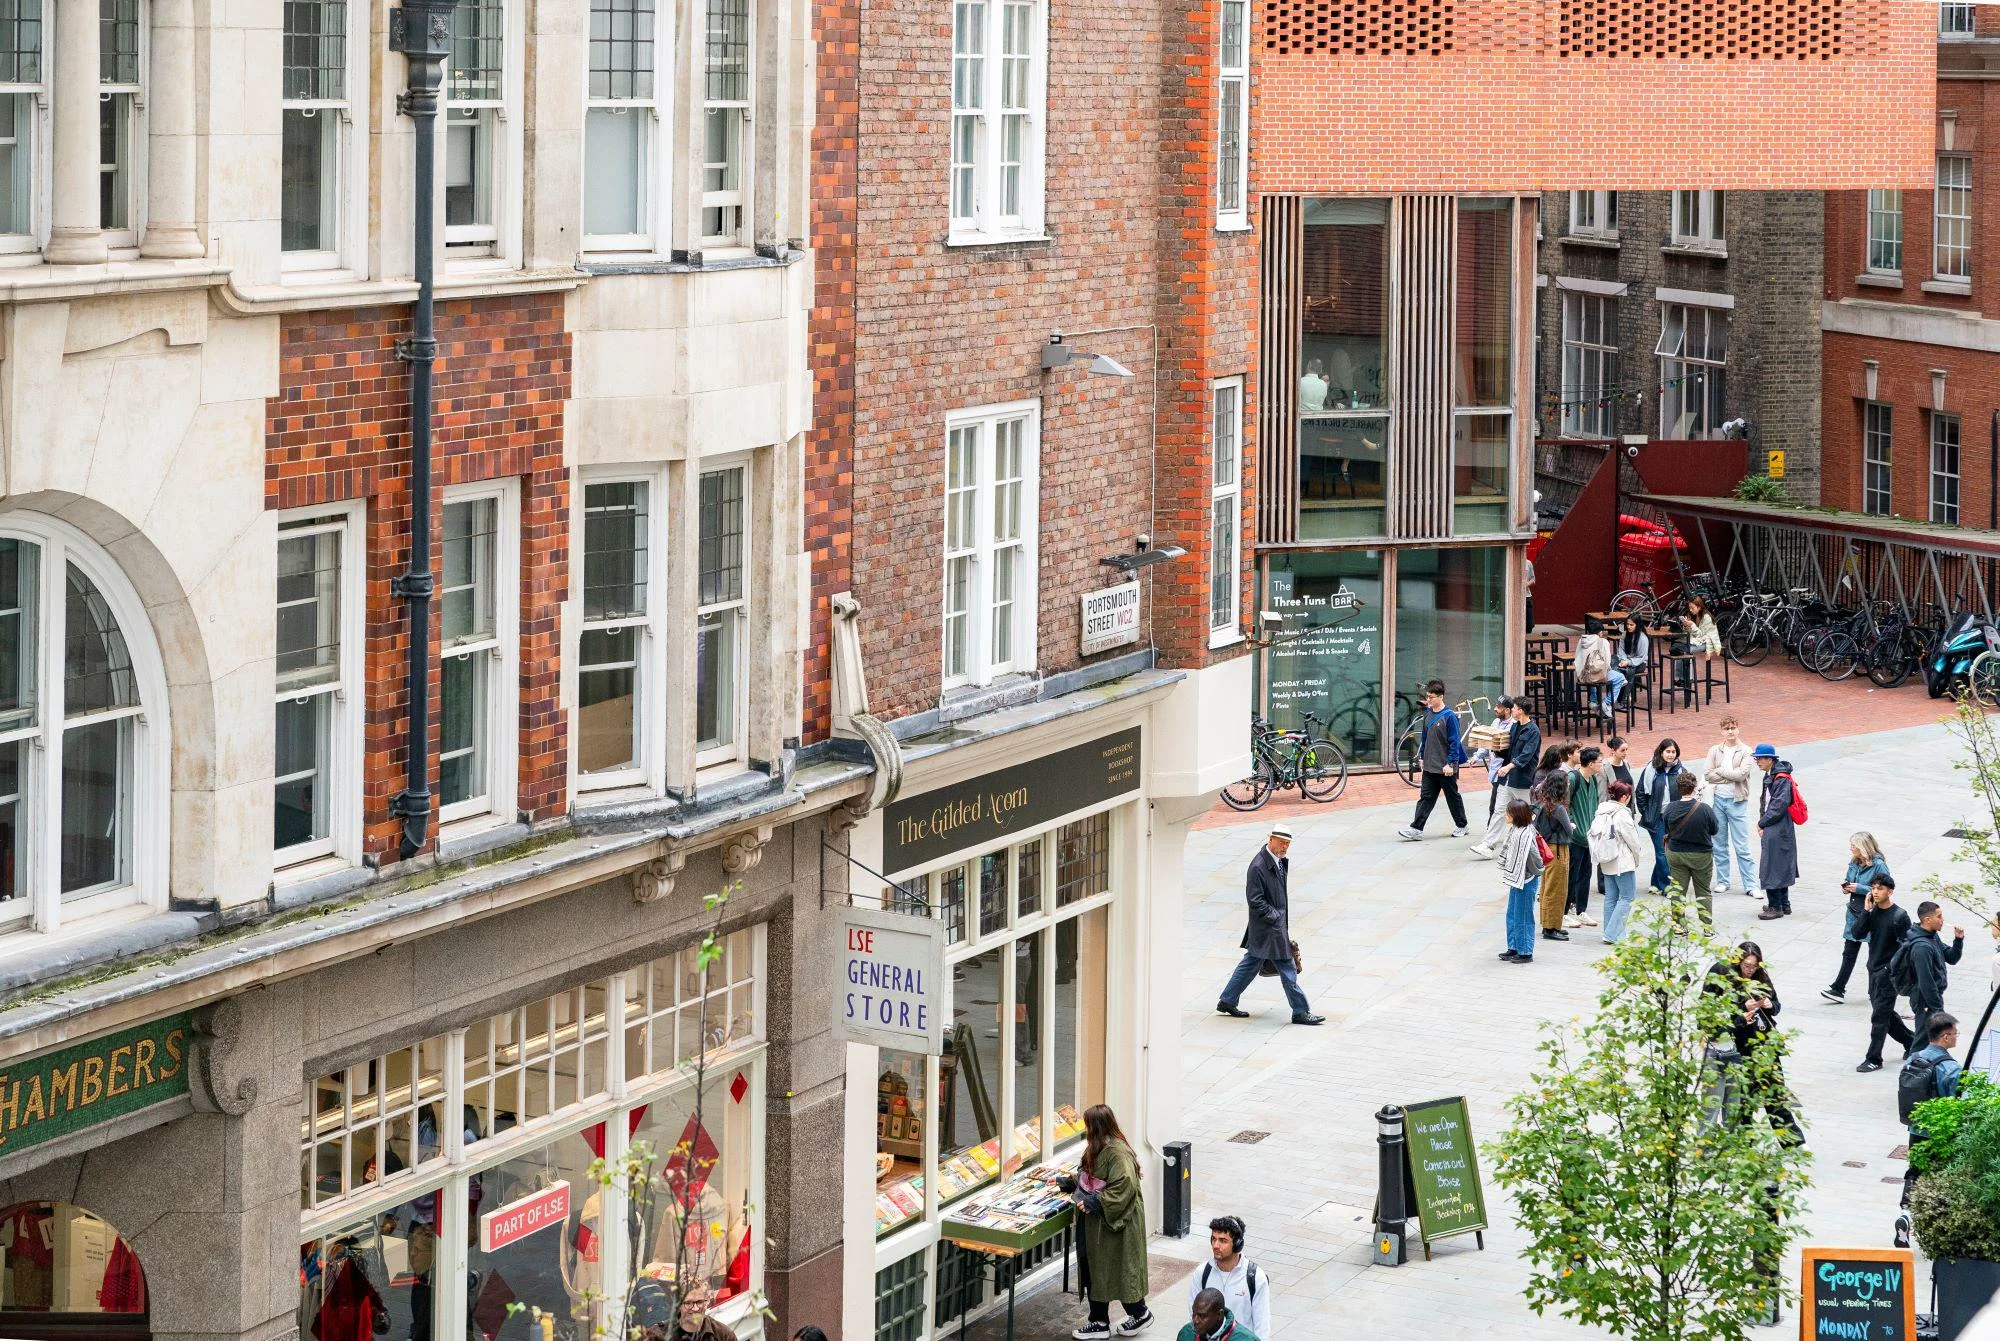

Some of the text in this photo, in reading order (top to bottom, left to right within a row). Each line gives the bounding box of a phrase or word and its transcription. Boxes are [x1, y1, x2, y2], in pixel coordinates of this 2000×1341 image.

[1274, 580, 1291, 591] The
[1087, 588, 1137, 616] PORTSMOUTH
[1273, 594, 1326, 607] Three Tuns
[1334, 596, 1352, 606] BAR
[1087, 609, 1133, 635] STREET WC2
[1284, 628, 1300, 636] Music
[1304, 628, 1321, 636] Sorts
[1272, 680, 1300, 688] MONDAY
[1272, 691, 1291, 700] Weekly
[1297, 690, 1311, 699] Daily
[1102, 741, 1134, 758] INDEPENDENT
[1108, 755, 1134, 770] BOOKSHOP
[1108, 772, 1121, 784] SINCE
[897, 786, 1028, 846] The Gilded Acorn
[848, 928, 874, 954] LSE
[847, 958, 925, 995] GENERAL
[846, 992, 927, 1030] STORE
[0, 1028, 184, 1140] HAMBERS
[1415, 1116, 1459, 1137] We are Open
[1429, 1138, 1454, 1152] Please
[1423, 1158, 1444, 1172] Come
[1451, 1153, 1466, 1169] and
[1436, 1174, 1462, 1188] Browse
[495, 1195, 564, 1240] PART OF LSE
[1818, 1262, 1901, 1300] George IV
[1818, 1316, 1871, 1341] MONDAY
